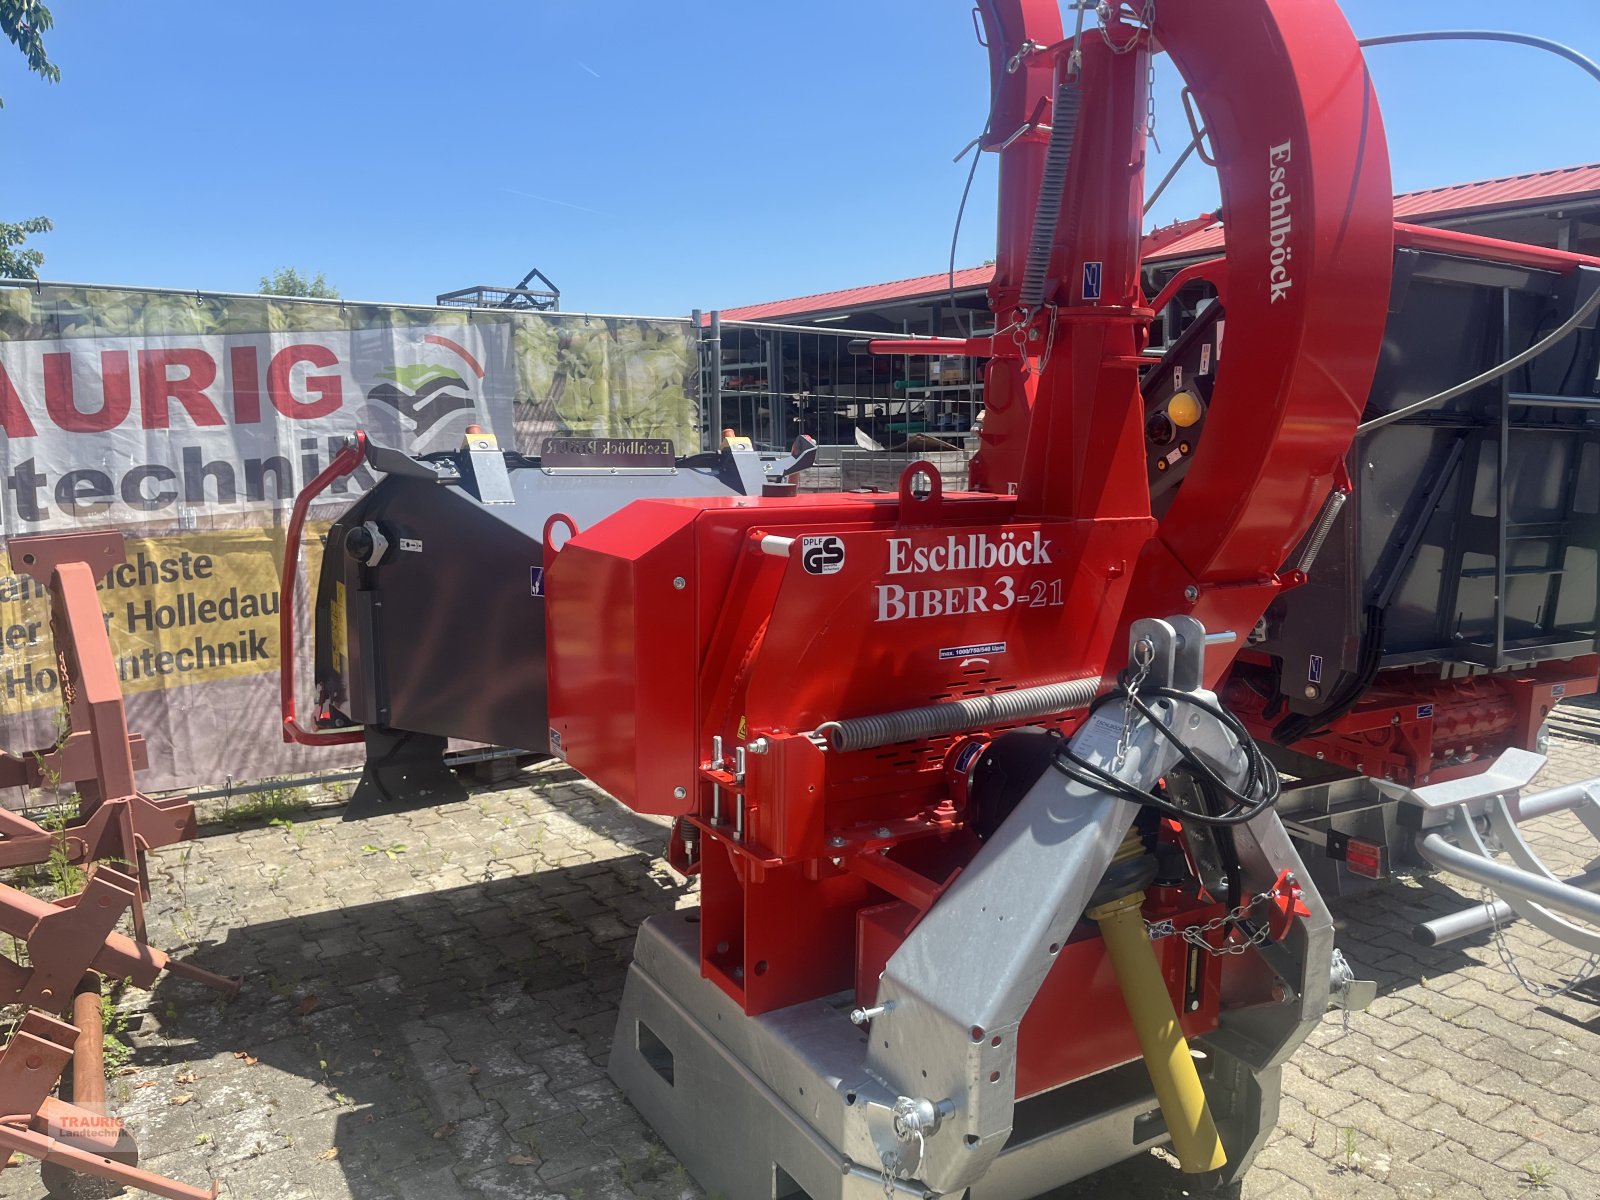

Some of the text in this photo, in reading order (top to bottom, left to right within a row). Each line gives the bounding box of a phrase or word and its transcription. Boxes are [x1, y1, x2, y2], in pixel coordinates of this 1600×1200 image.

[1269, 139, 1292, 304] Eschlböck
[804, 538, 823, 546] DPLF
[886, 531, 1053, 575] Eschlböck
[127, 587, 280, 633] Holledau
[874, 575, 1064, 622] BIBER 3-21
